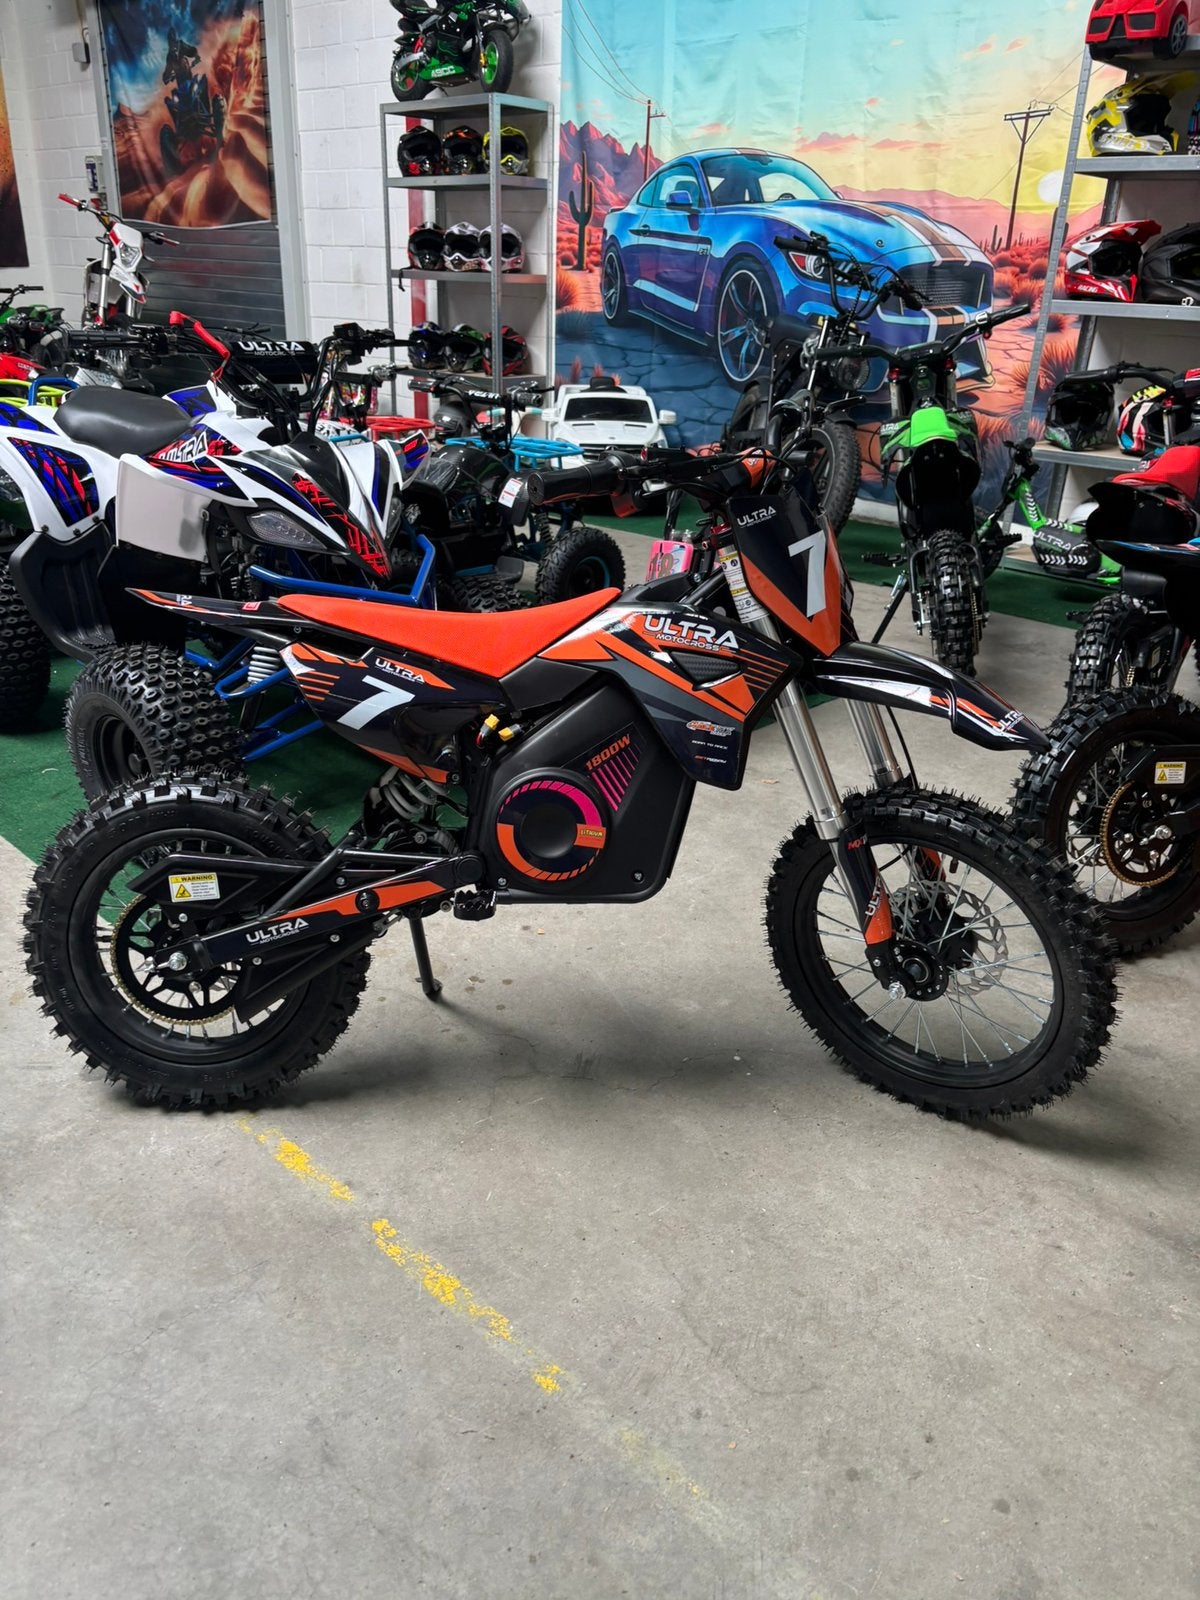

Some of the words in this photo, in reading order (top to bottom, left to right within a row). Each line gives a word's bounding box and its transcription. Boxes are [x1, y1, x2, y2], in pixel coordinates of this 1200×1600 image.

[238, 341, 306, 351] ULTRA
[737, 506, 777, 526] ULTRA
[788, 530, 827, 618] 7
[644, 614, 739, 649] ULTRA
[656, 634, 720, 651] MOTOCROSS
[375, 658, 425, 683] ULTRA
[337, 675, 416, 731] 7
[586, 734, 630, 770] 1800W
[246, 918, 310, 943] ULTRA
